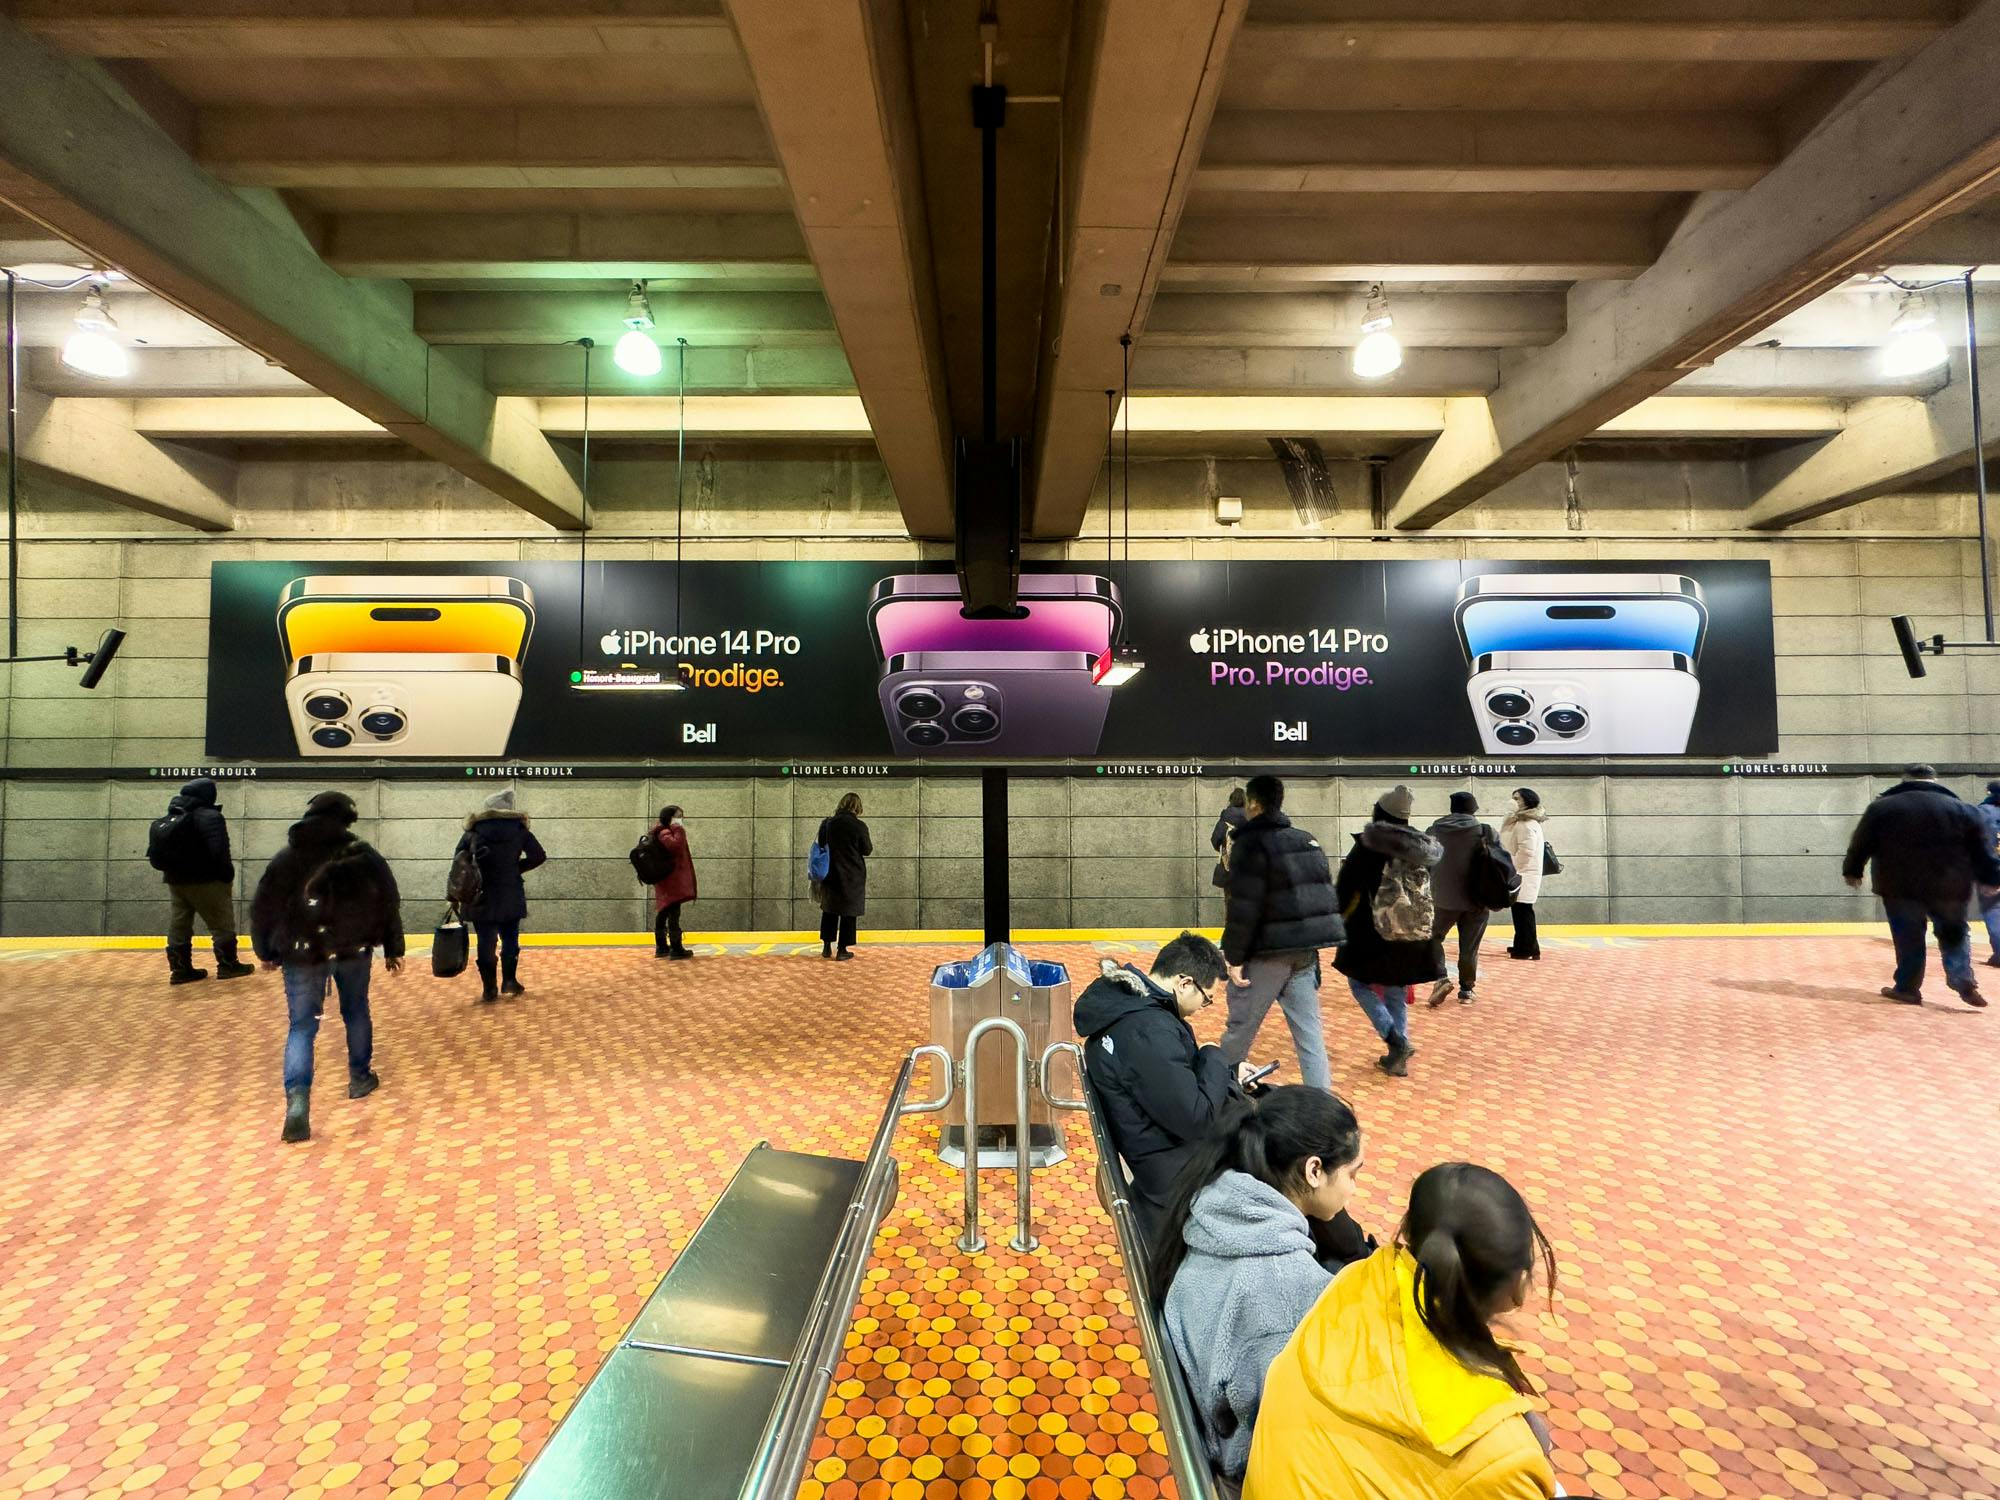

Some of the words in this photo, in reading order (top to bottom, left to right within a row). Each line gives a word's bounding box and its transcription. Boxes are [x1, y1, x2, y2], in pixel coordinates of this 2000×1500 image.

[624, 630, 717, 655] iPhone
[720, 630, 750, 655] 14
[756, 630, 801, 655] Pro
[1212, 629, 1305, 654] iPhone
[1308, 629, 1338, 654] 14
[1343, 629, 1389, 654] Pro
[1210, 661, 1261, 686] Pro.
[1266, 661, 1374, 691] Prodige.
[683, 723, 717, 743] Bell
[1274, 721, 1308, 741] Bell
[161, 768, 257, 776] LIONEL-GROULX
[477, 768, 573, 776] LIONEL-GROULX
[792, 766, 889, 775] LIONEL-GROULX
[1108, 765, 1204, 774] LIONEL-GROULX
[1421, 765, 1517, 774] LIONEL-GROULX
[1733, 764, 1828, 773] LIONEL-GROULX
